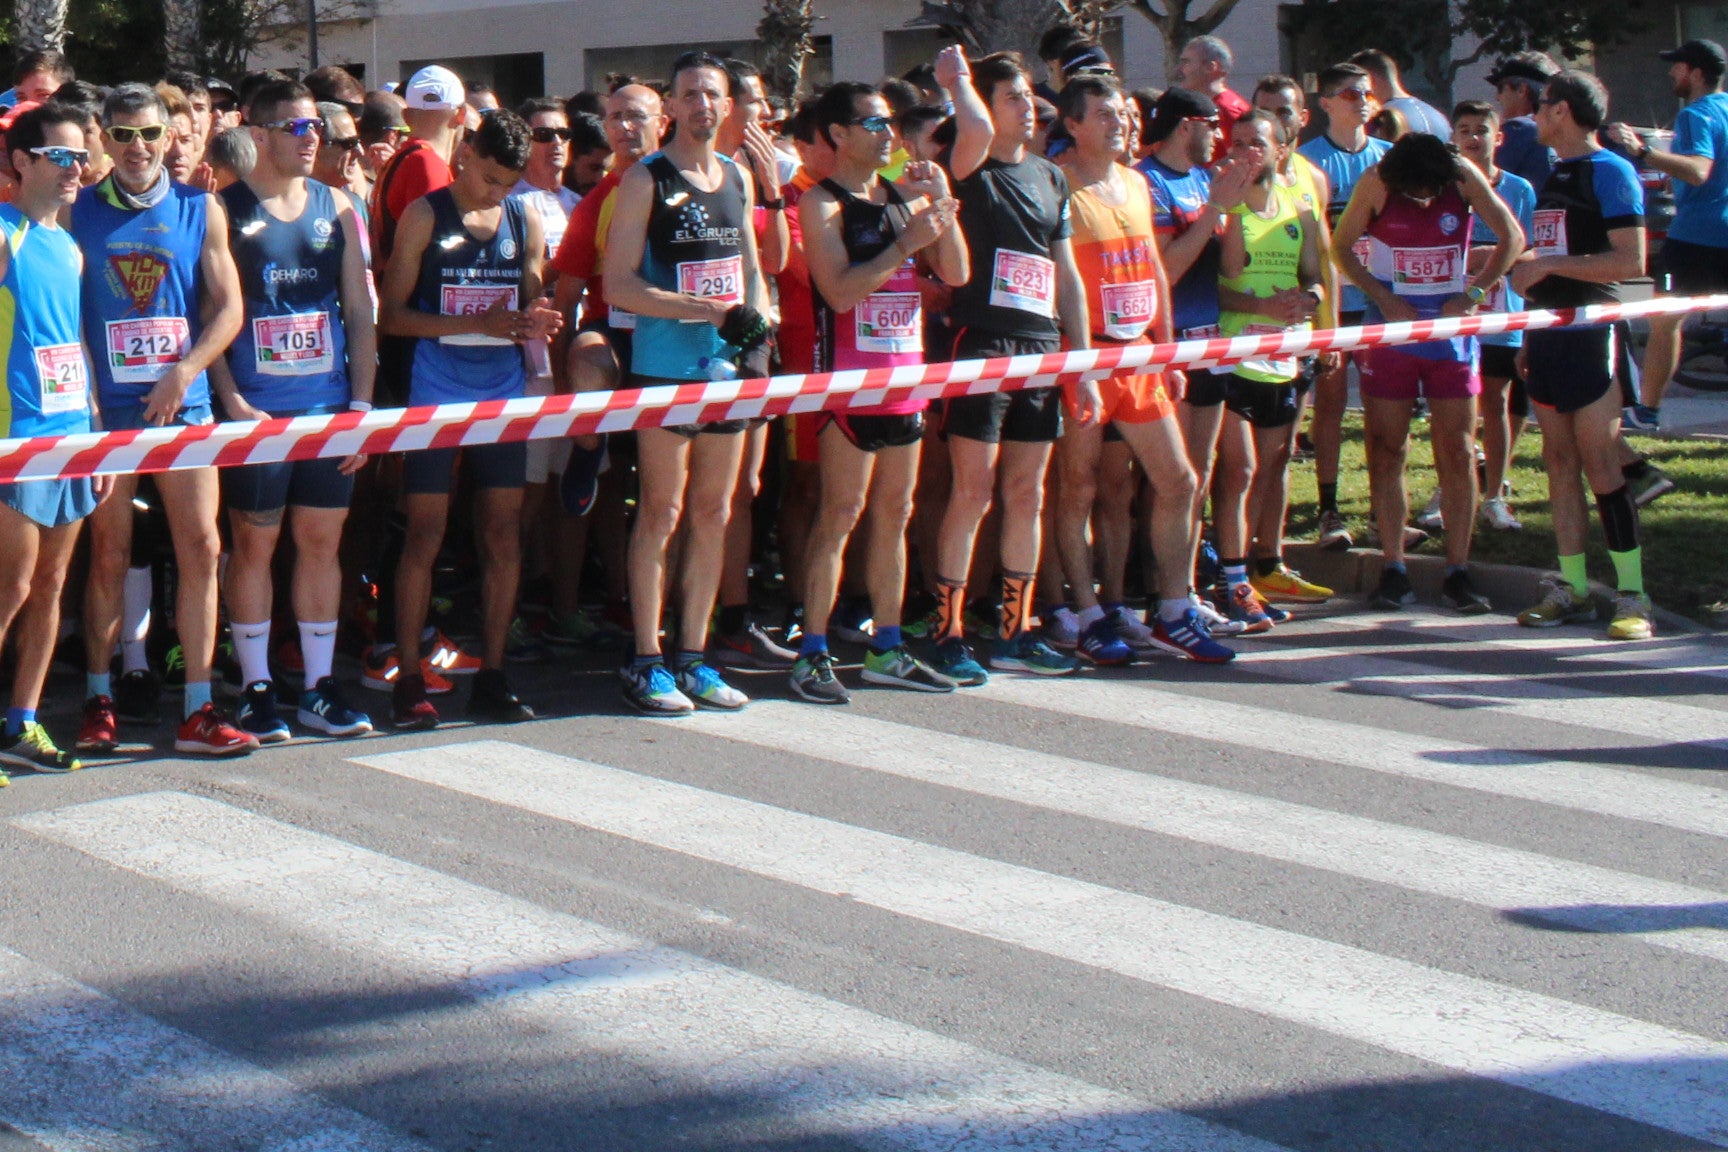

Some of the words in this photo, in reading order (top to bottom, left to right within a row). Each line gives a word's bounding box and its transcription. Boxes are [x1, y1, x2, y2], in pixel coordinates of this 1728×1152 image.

[675, 230, 693, 241] EL
[697, 227, 739, 239] GRUPO
[270, 268, 318, 281] DEHARO
[1411, 260, 1444, 276] 587
[702, 276, 733, 296] 292
[1013, 269, 1043, 290] 623
[1122, 299, 1147, 316] 662
[877, 310, 909, 328] 600
[131, 335, 171, 356] 212
[280, 331, 316, 350] 105
